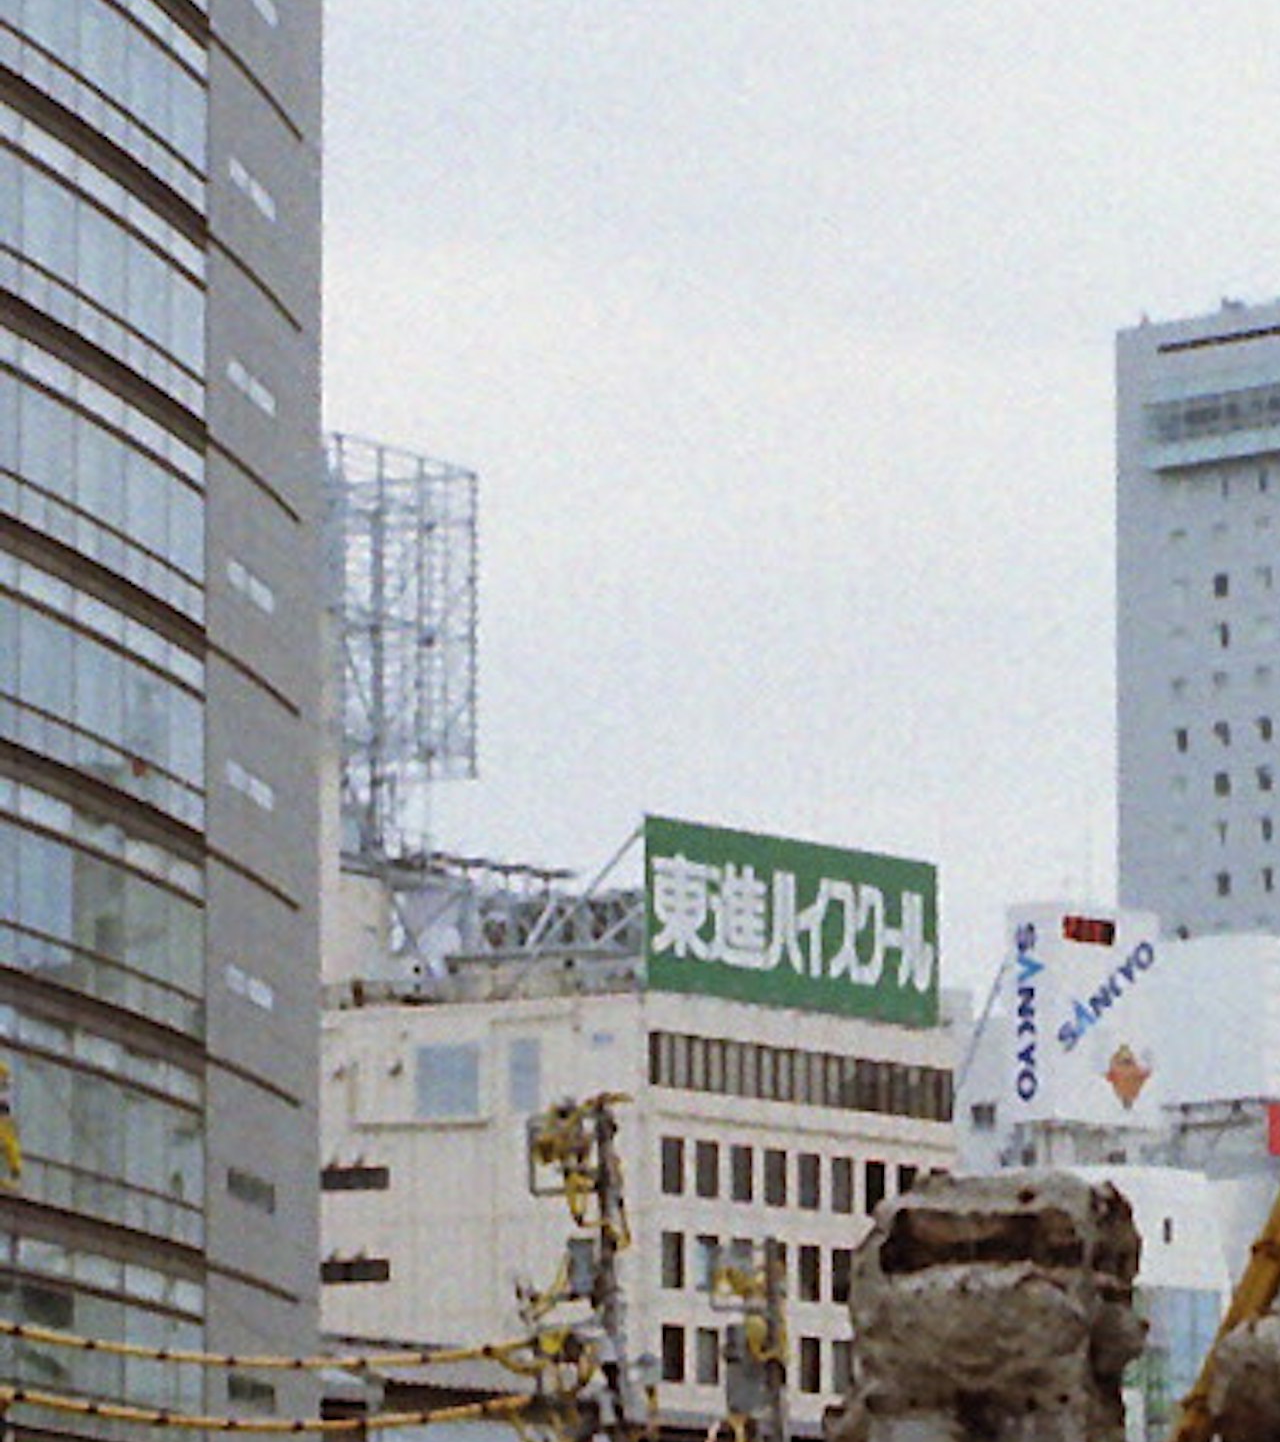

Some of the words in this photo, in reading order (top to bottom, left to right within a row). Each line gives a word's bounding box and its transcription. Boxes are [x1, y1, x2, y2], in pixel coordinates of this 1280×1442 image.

[650, 852, 934, 995] 東進ハイスクール
[1016, 921, 1045, 1102] SANYO
[1058, 940, 1156, 1052] SANYO
